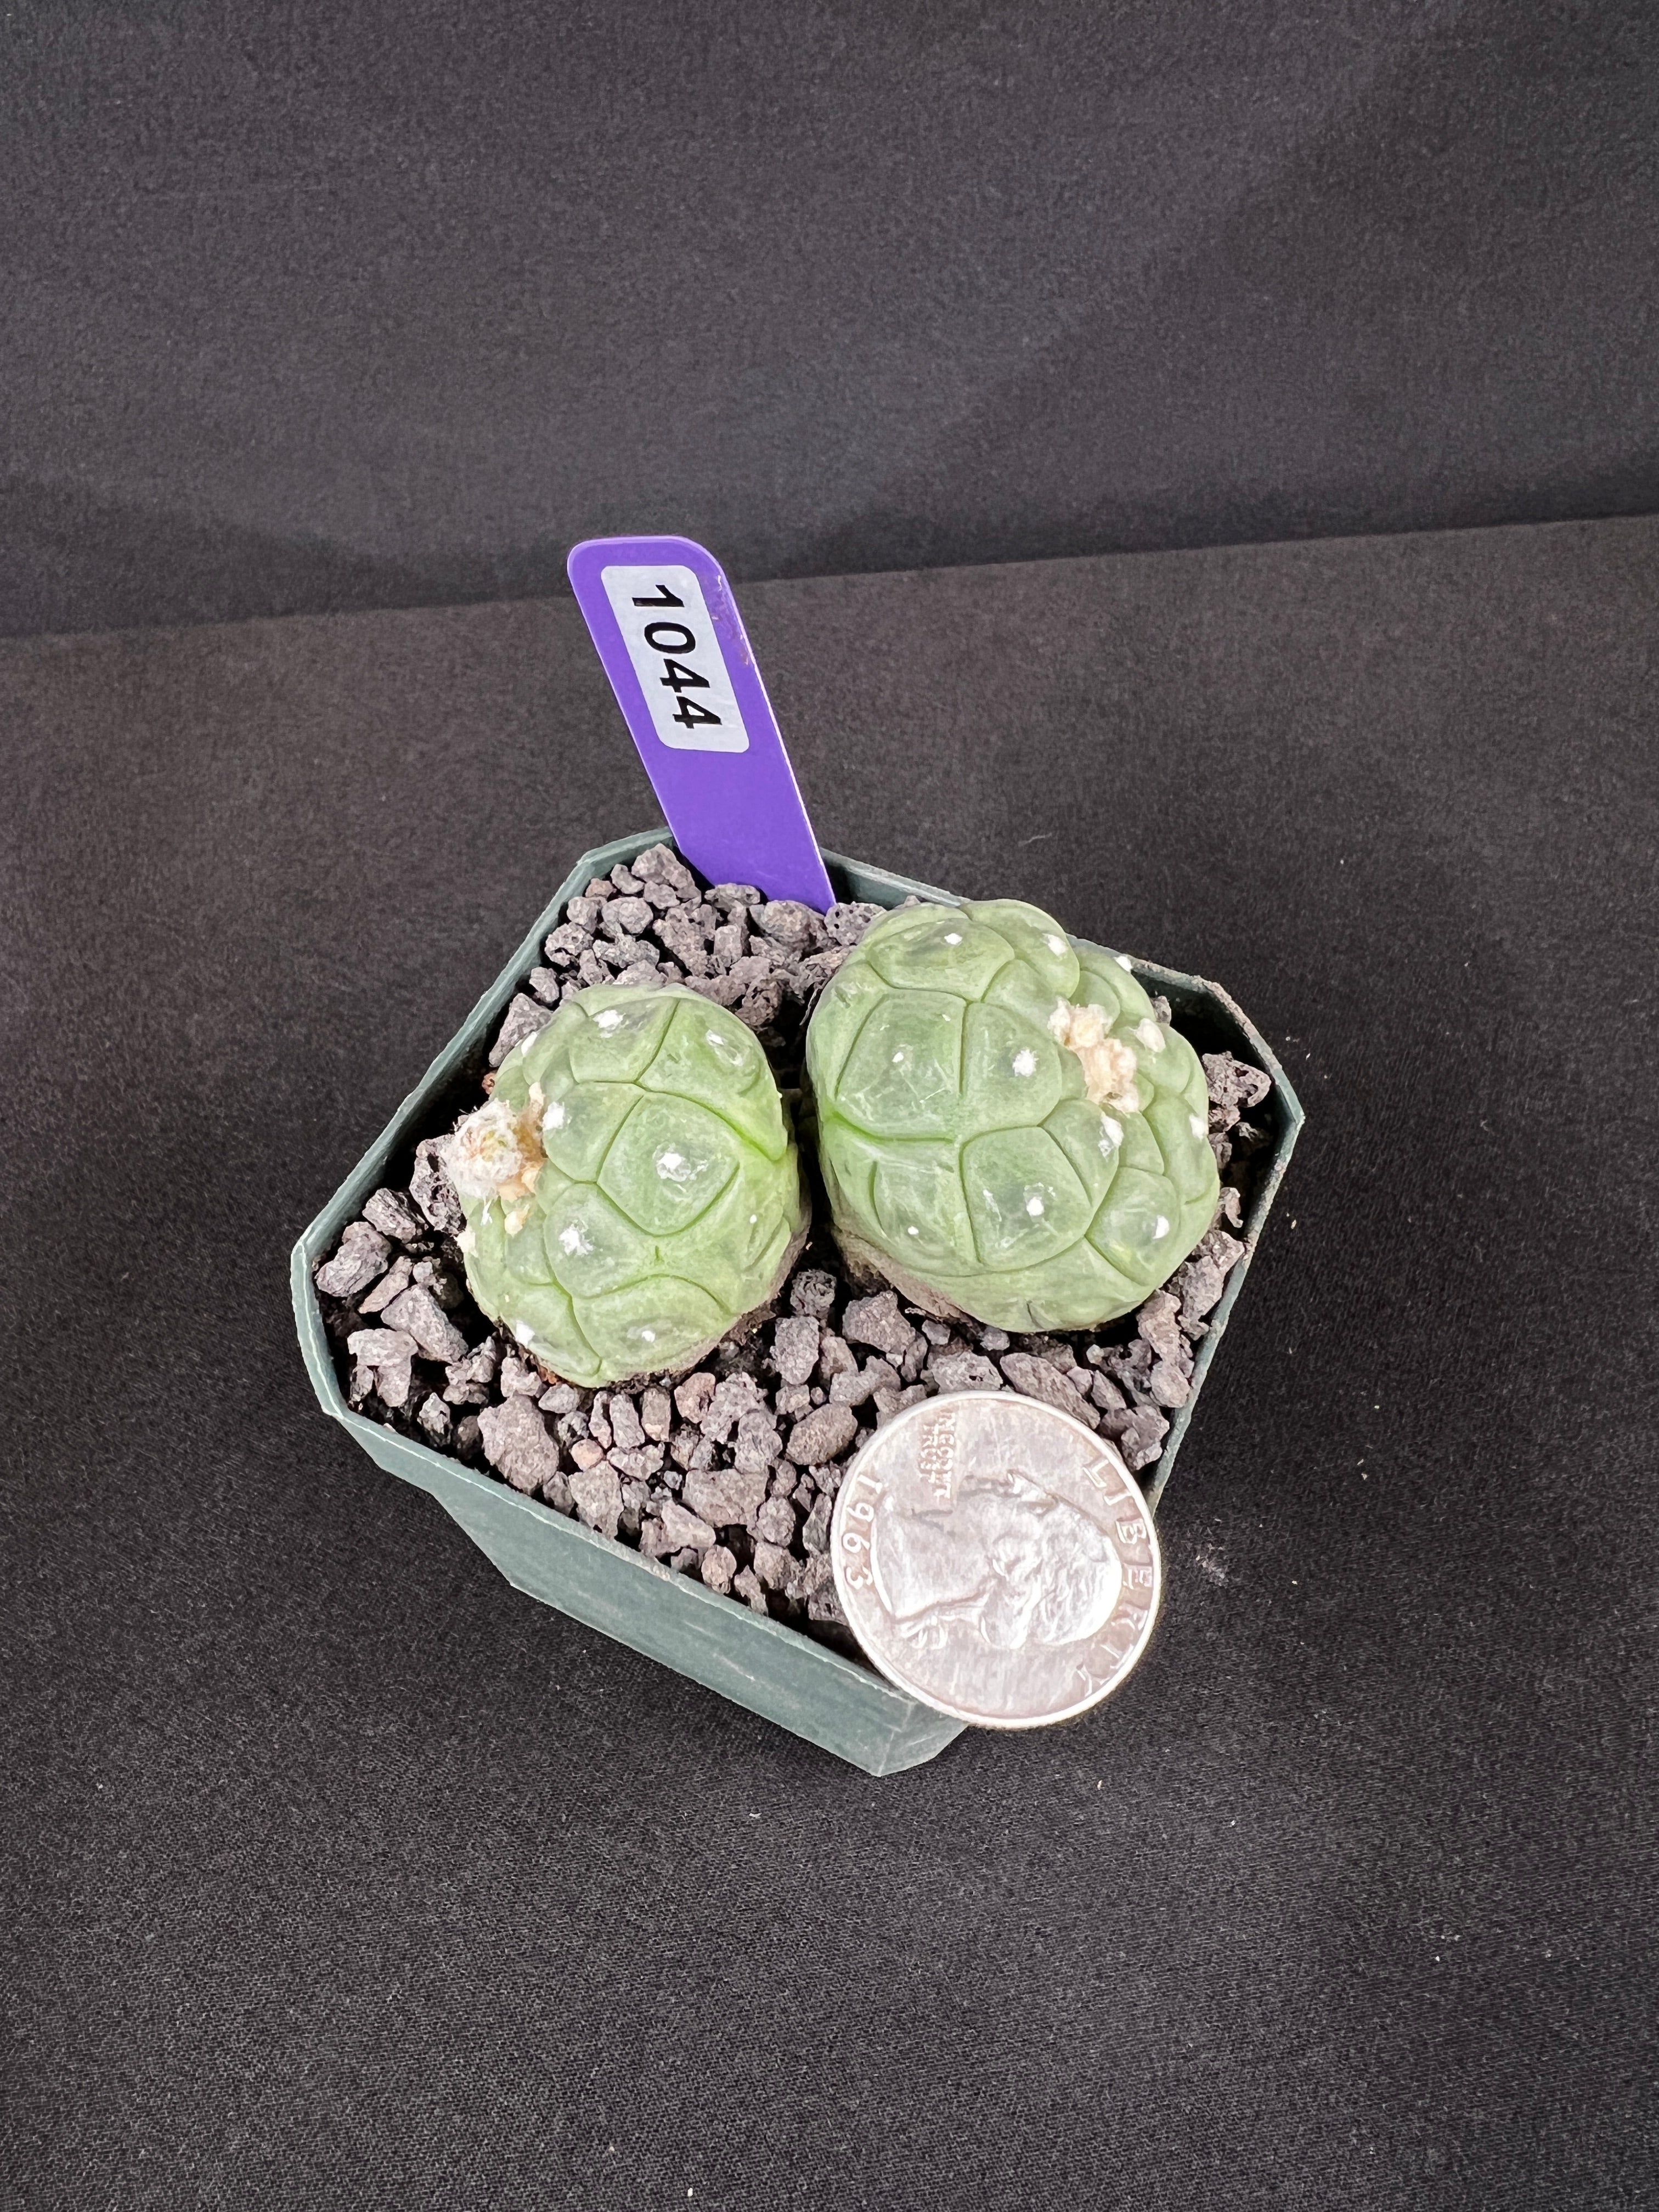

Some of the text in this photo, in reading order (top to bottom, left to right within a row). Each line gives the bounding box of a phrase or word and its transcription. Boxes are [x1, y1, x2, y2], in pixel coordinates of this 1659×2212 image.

[632, 584, 723, 729] 1044
[842, 1473, 882, 1590] 1963
[1076, 1459, 1153, 1697] LIBERTY
